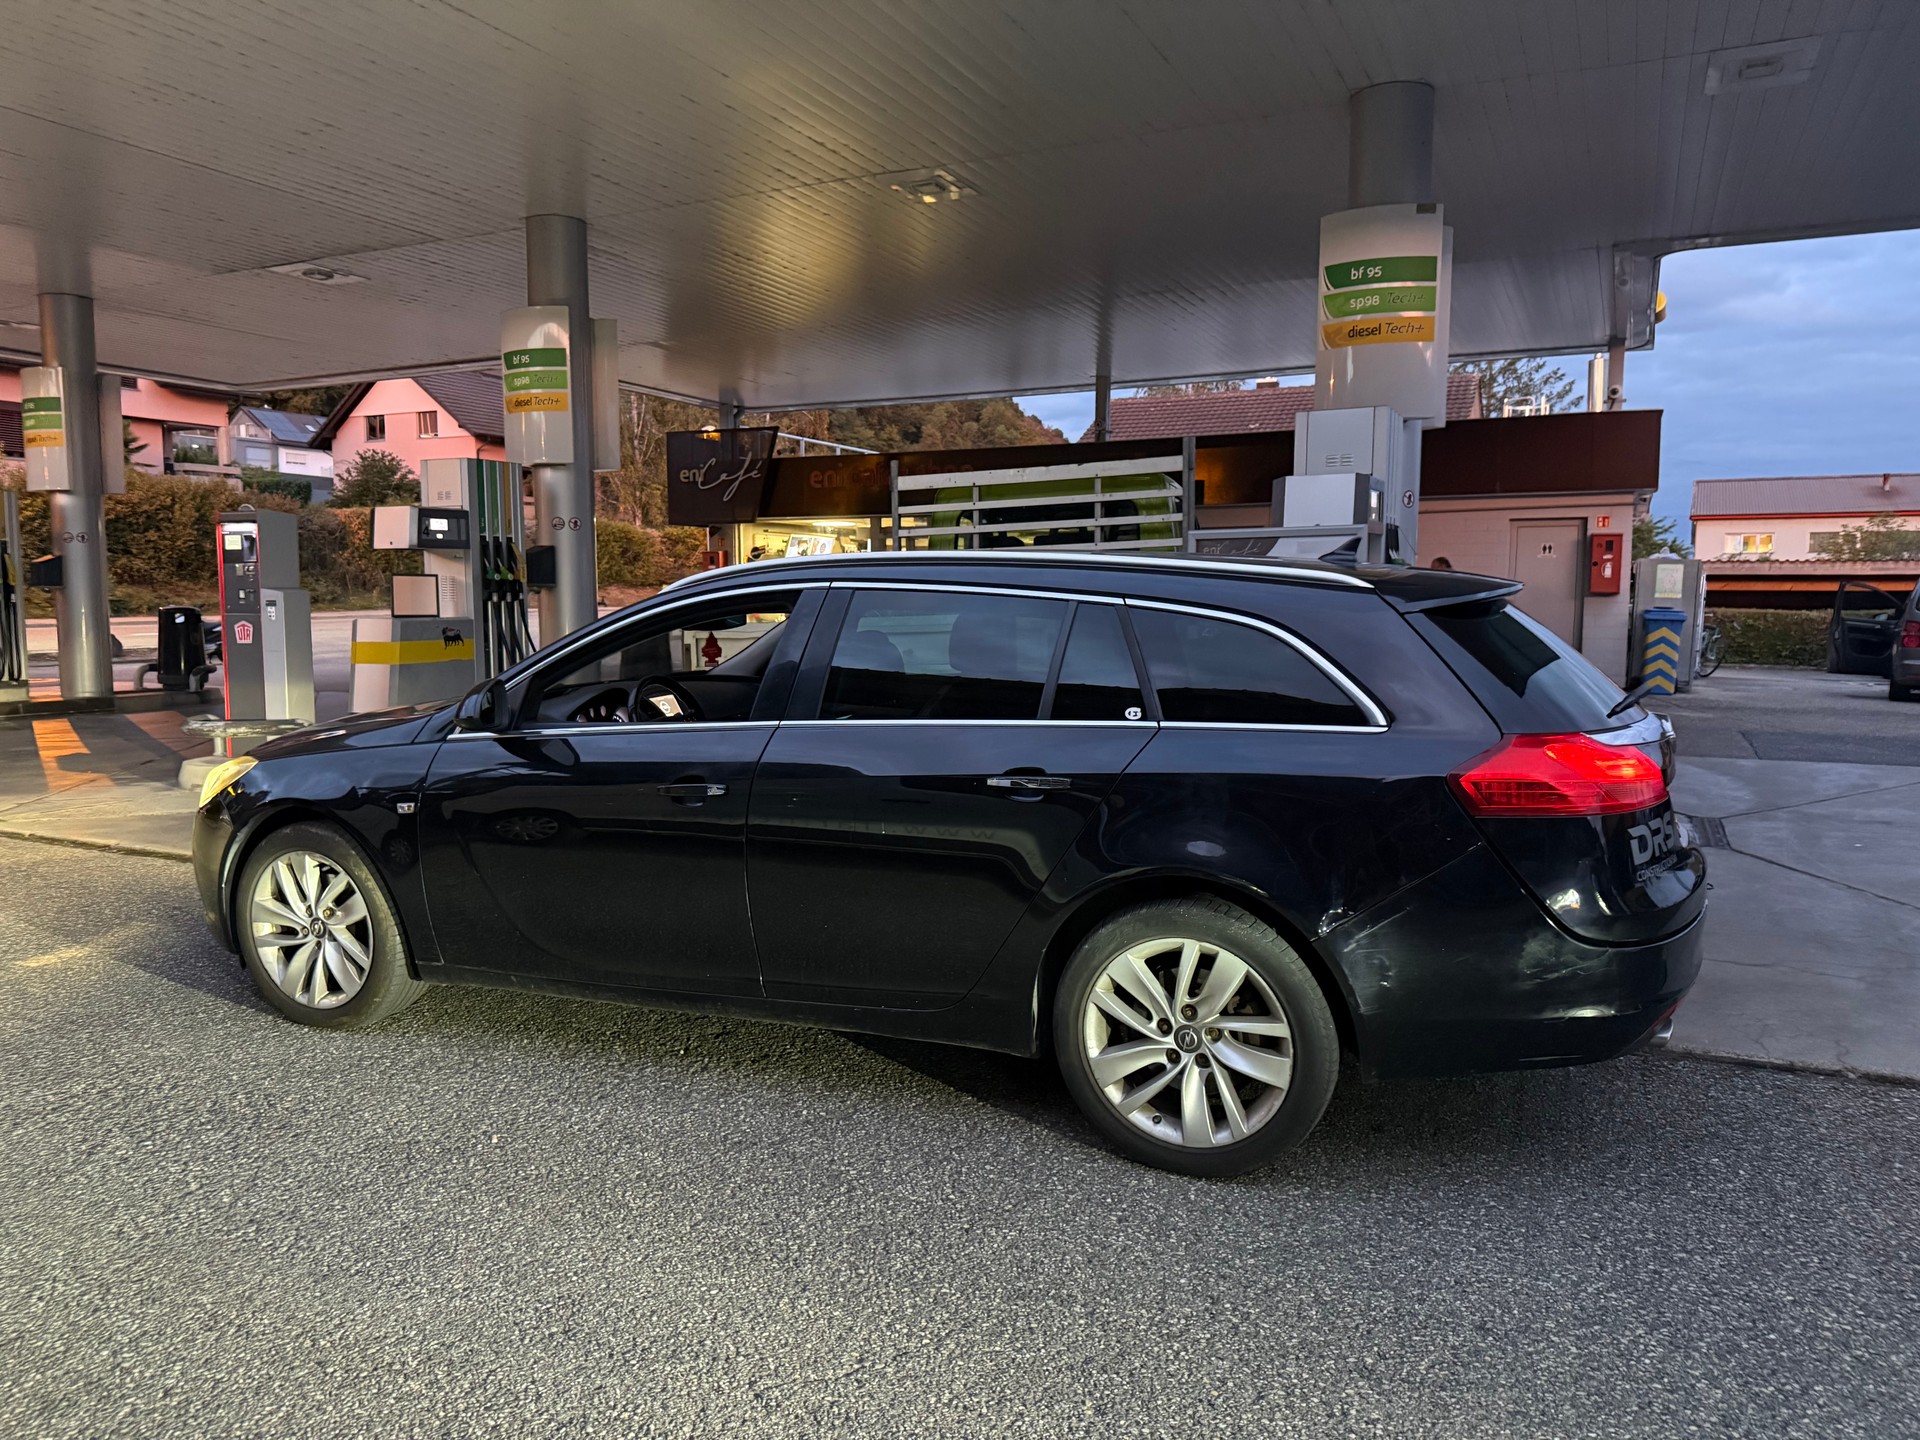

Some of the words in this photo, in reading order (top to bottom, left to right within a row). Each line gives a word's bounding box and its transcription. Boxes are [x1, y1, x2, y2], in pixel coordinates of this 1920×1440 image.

[1351, 266, 1365, 280] bf
[1367, 266, 1382, 278] 95
[1349, 295, 1380, 310] sp98
[1387, 292, 1425, 304] Tech+
[1347, 323, 1382, 339] diesel
[1385, 322, 1424, 334] Tech+
[512, 355, 520, 364] bf
[520, 355, 530, 364] 95
[513, 376, 530, 386] sp98
[514, 397, 533, 407] diesel
[533, 396, 561, 405] Tech+
[1627, 811, 1675, 866] DRS
